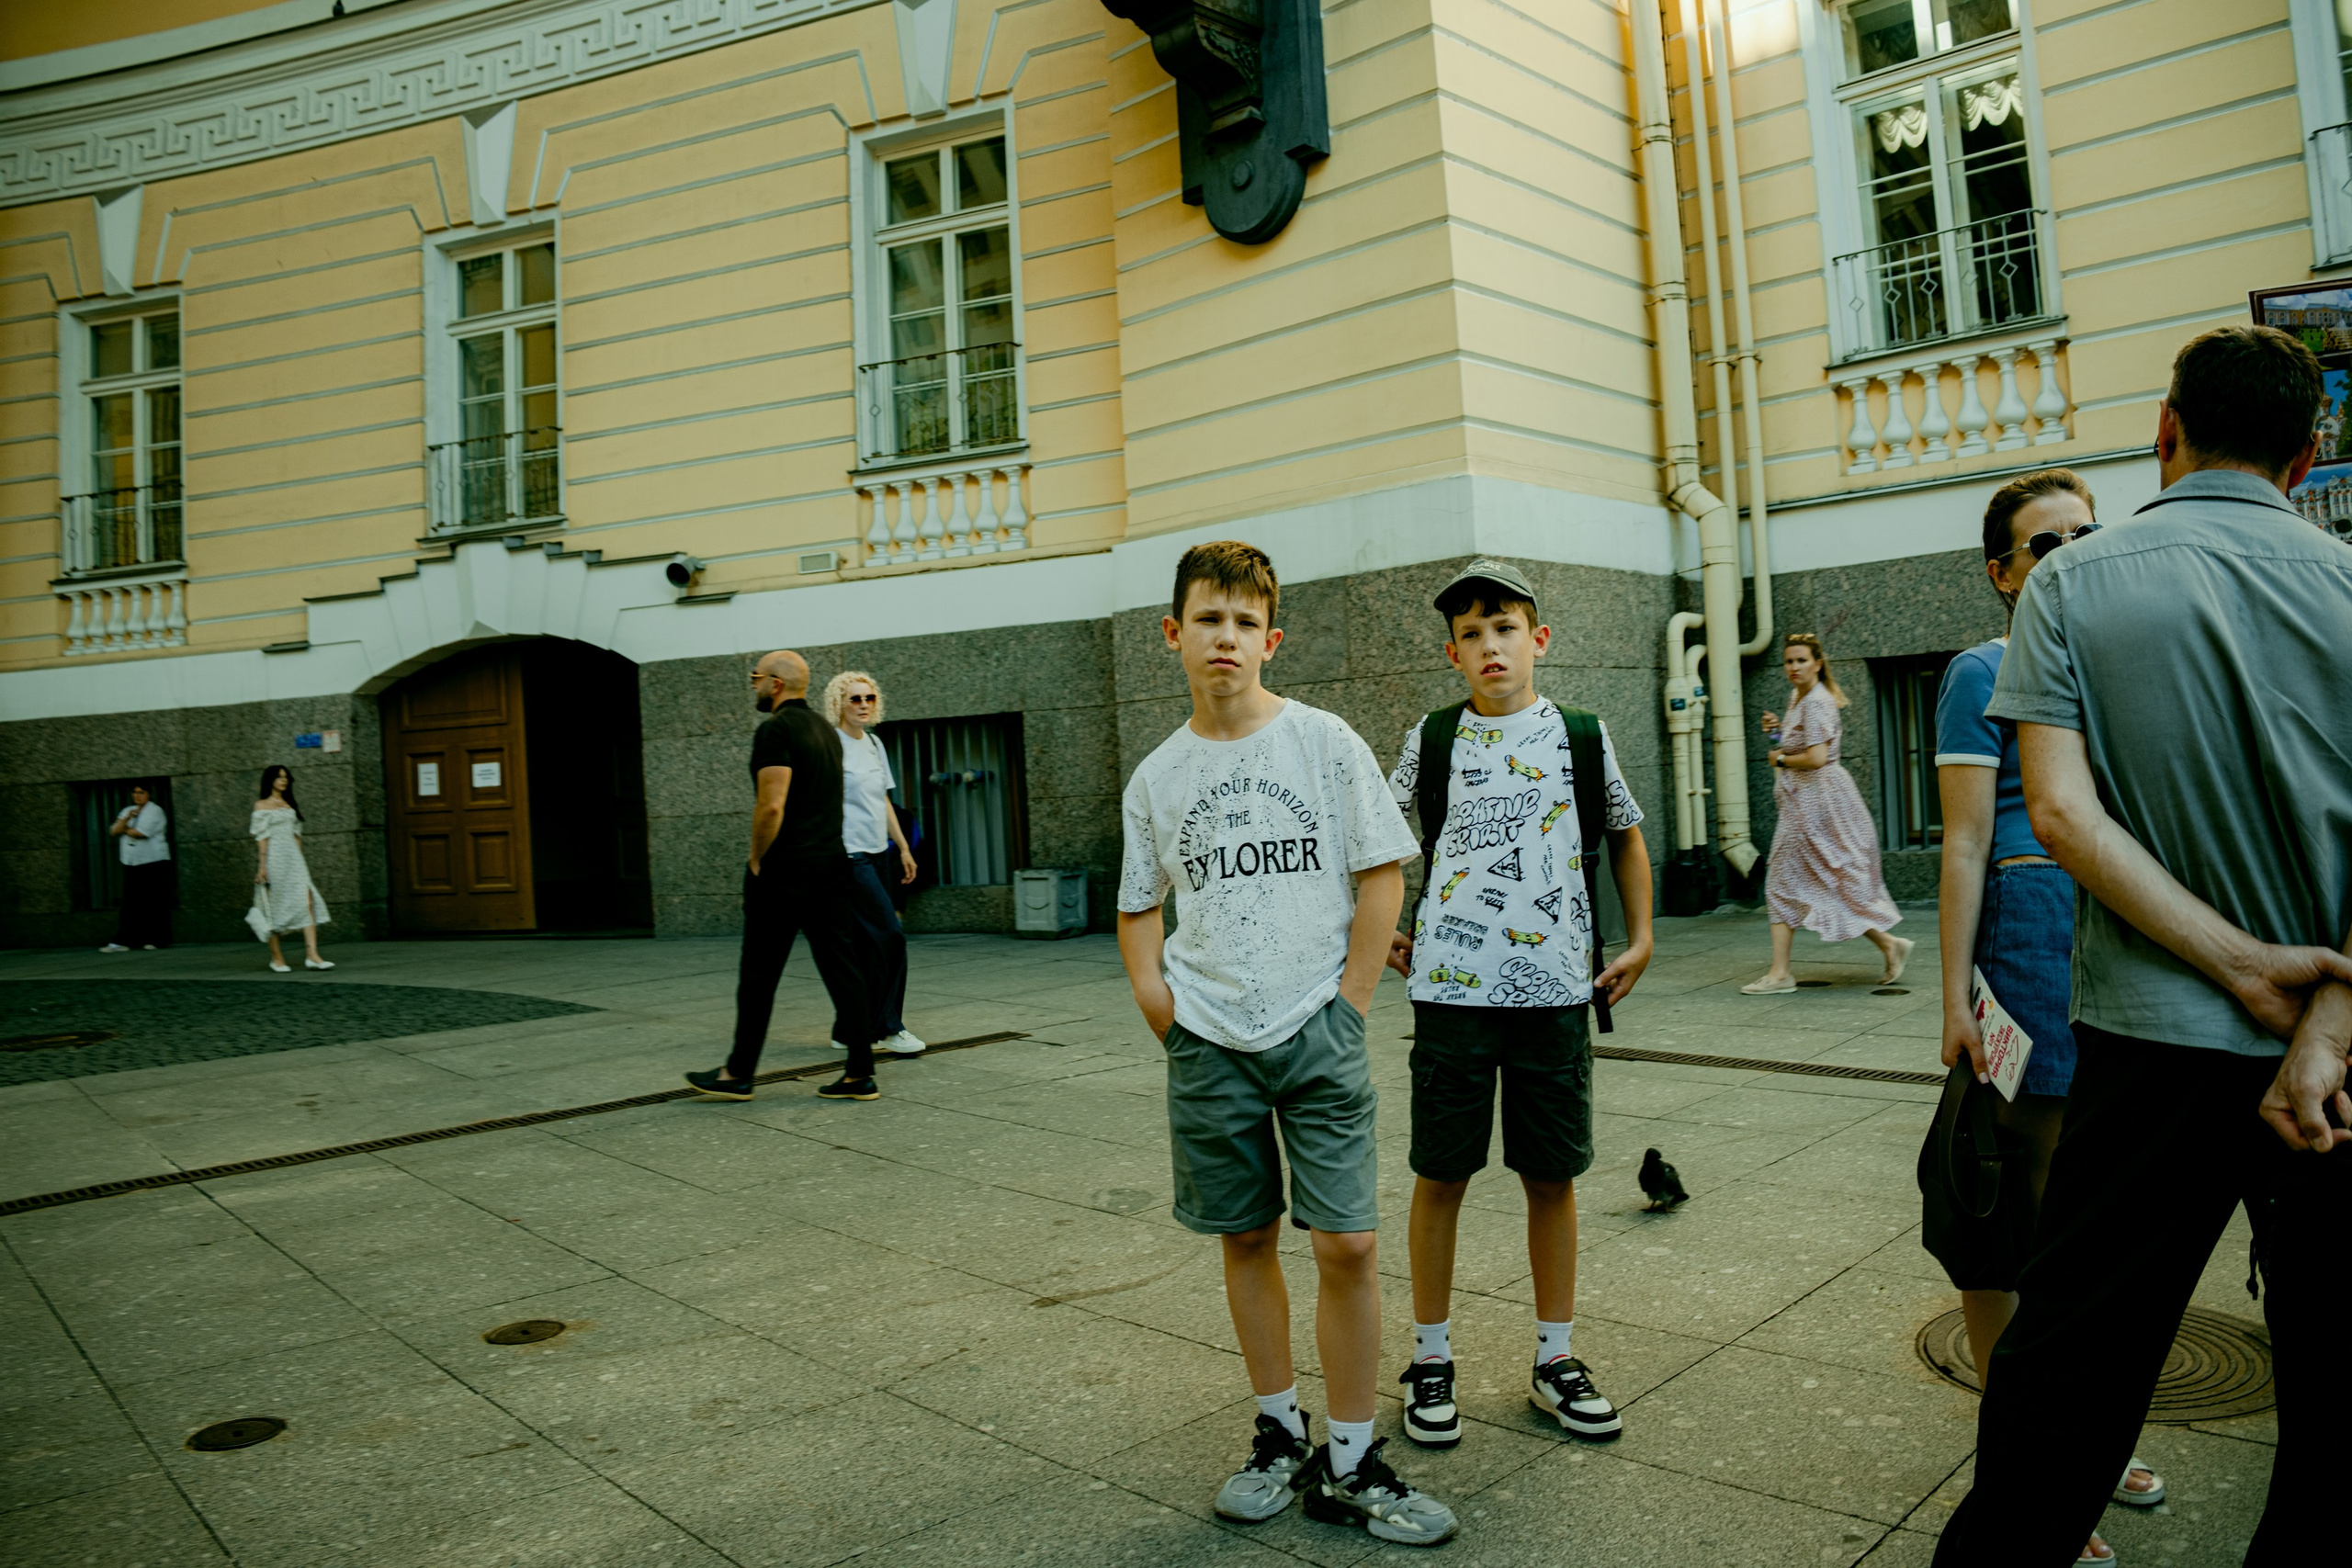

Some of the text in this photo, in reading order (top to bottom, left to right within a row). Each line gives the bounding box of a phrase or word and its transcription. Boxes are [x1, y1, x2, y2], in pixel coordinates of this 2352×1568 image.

[1180, 778, 1318, 857] EXPAND YOUR HORIZON
[1225, 810, 1251, 829] THE
[1434, 925, 1484, 953] RULES
[1991, 1024, 2014, 1079] ВИКТОРИЯ
